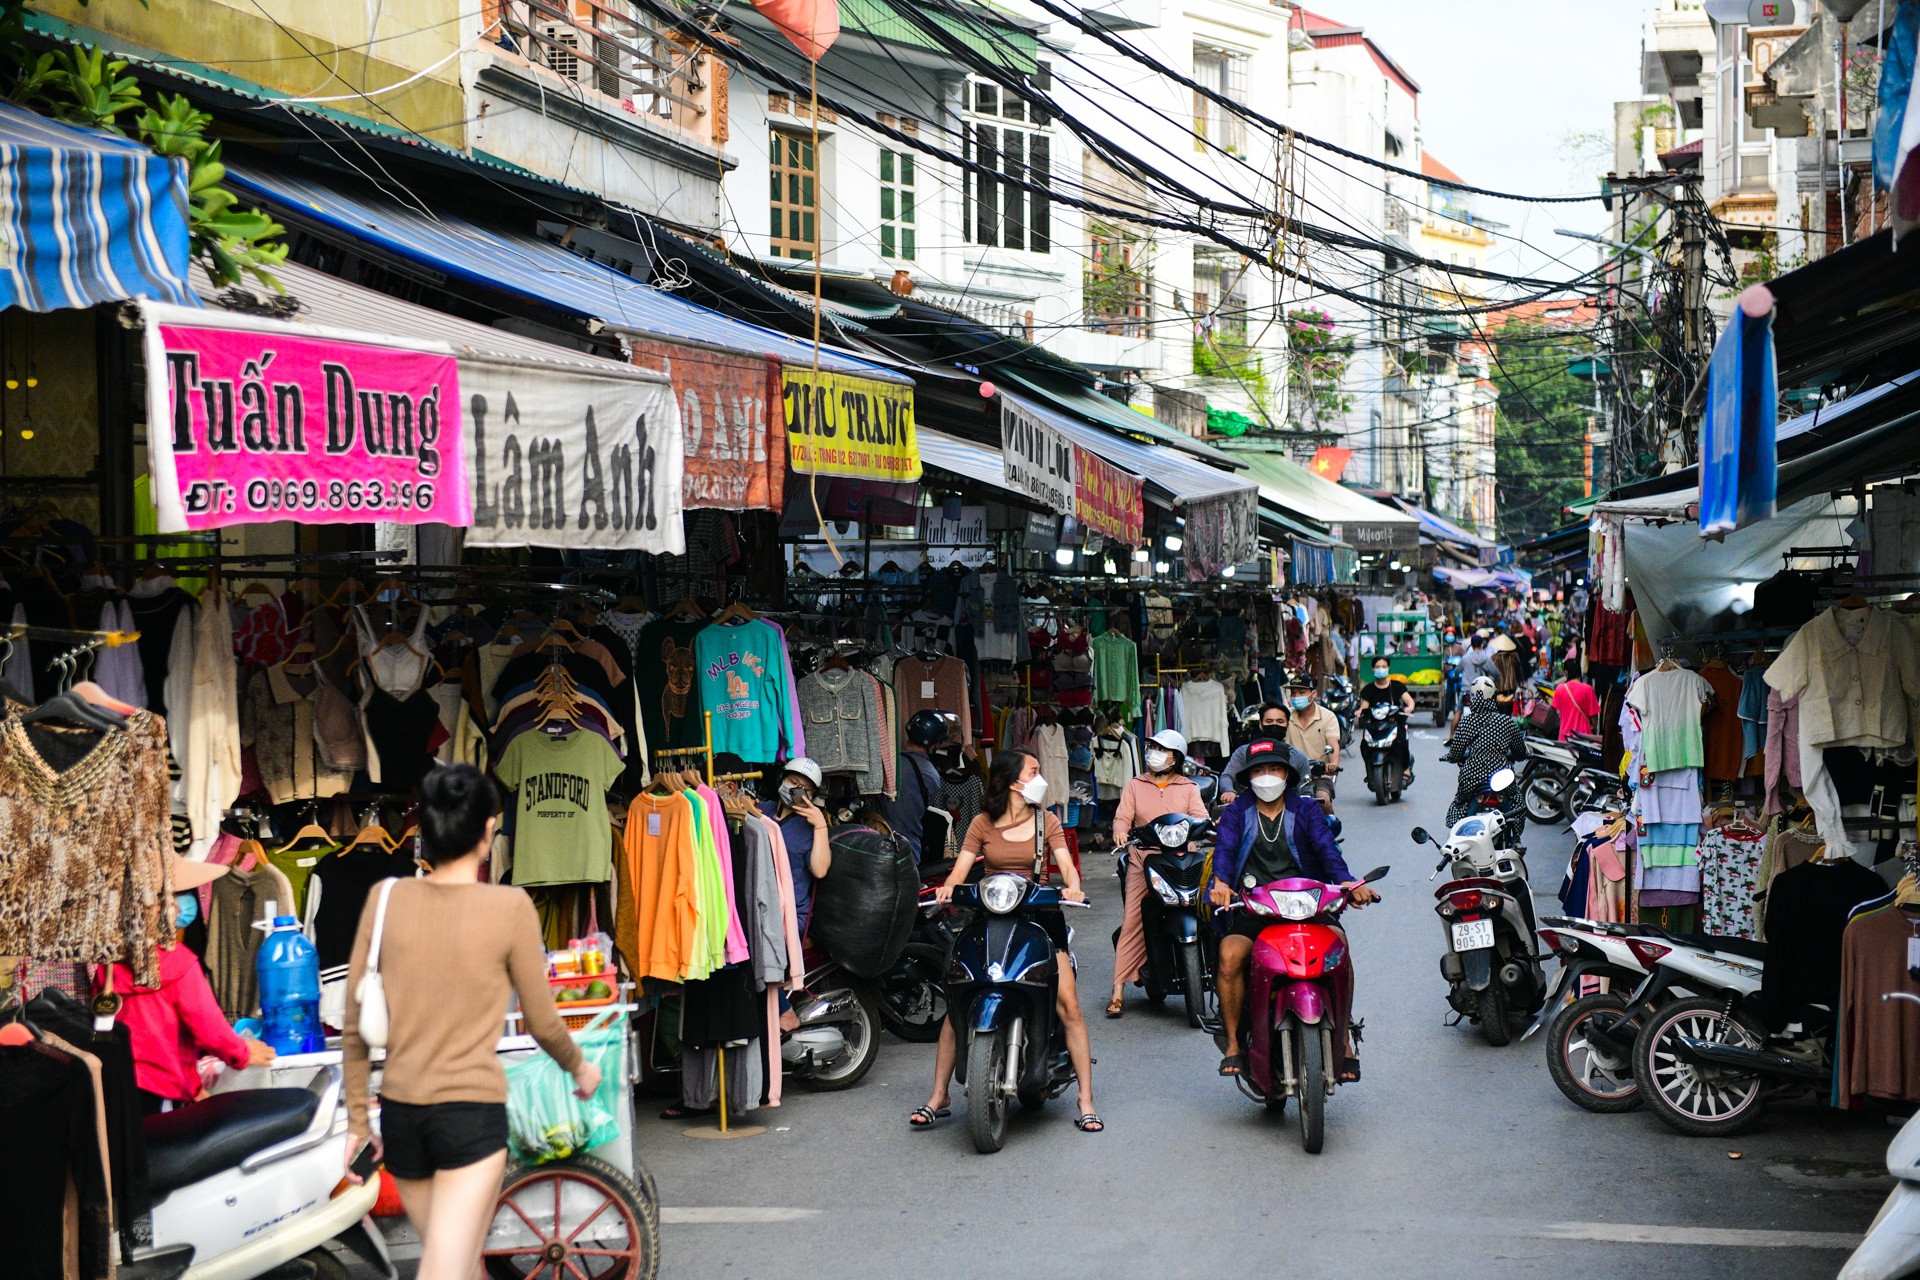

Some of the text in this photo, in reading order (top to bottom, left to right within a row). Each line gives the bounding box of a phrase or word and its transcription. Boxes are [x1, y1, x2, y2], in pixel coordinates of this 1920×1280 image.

[165, 351, 441, 478] Tuấn Dung
[471, 390, 657, 531] Lâm Anh
[707, 652, 741, 681] MLB
[726, 671, 749, 699] LA
[525, 772, 590, 812] STANDFORD
[567, 811, 576, 819] OF
[1456, 934, 1492, 950] 905.12
[1458, 921, 1486, 937] 29-S1
